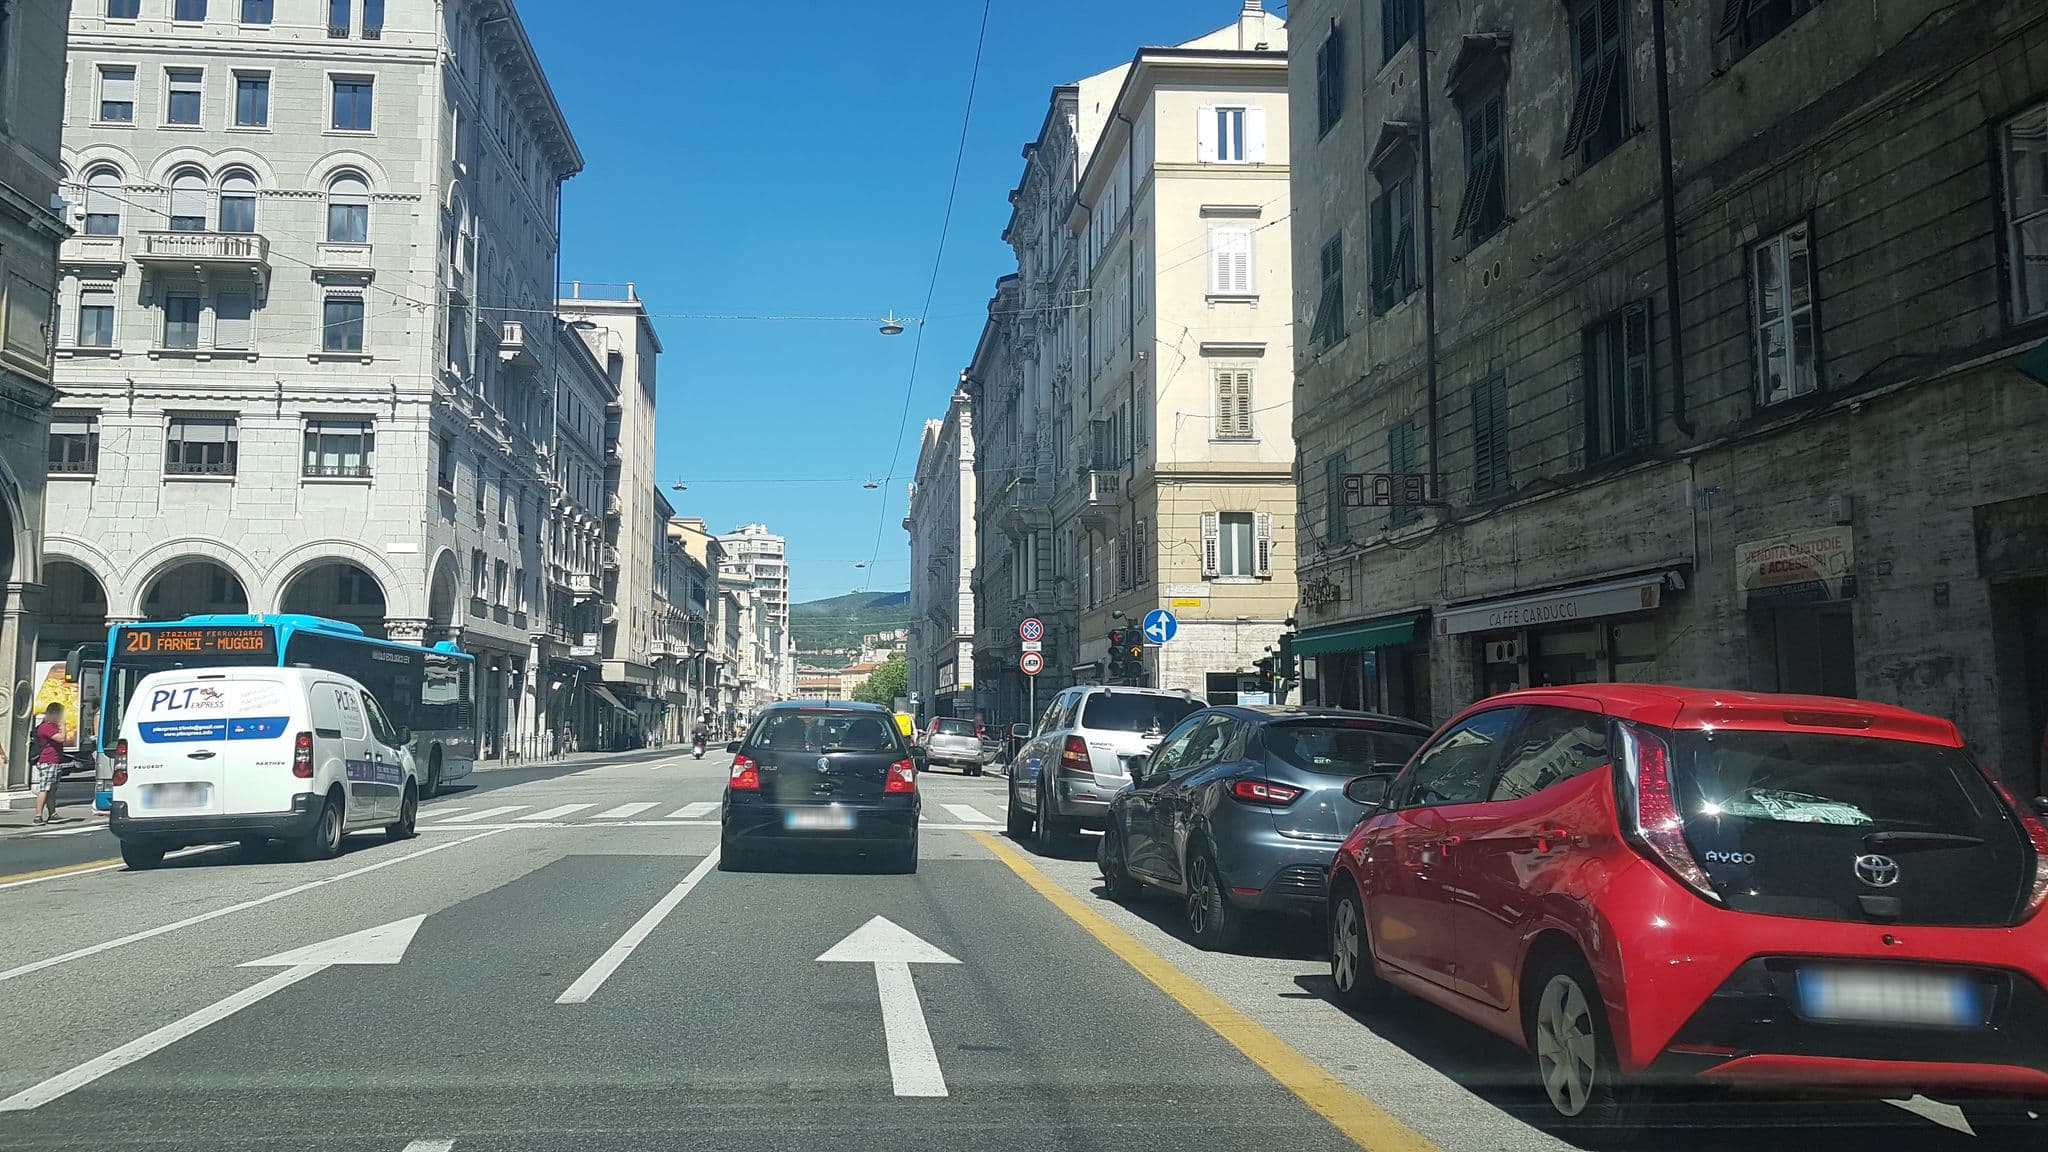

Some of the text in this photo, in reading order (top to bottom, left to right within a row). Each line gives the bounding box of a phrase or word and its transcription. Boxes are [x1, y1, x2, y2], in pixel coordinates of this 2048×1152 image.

[1744, 537, 1841, 563] VENDITA CUSTODIE
[1760, 554, 1827, 575] E ACCESSORI
[1488, 602, 1578, 627] CAFFÈ CARDUCCI
[127, 632, 151, 651] 20
[206, 630, 263, 638] FERROVIARIA
[157, 638, 202, 651] FARNEI
[217, 637, 264, 650] MUGGIA
[151, 687, 199, 712] PLT
[190, 700, 225, 709] EXPRESS
[1705, 850, 1756, 864] AYGO
